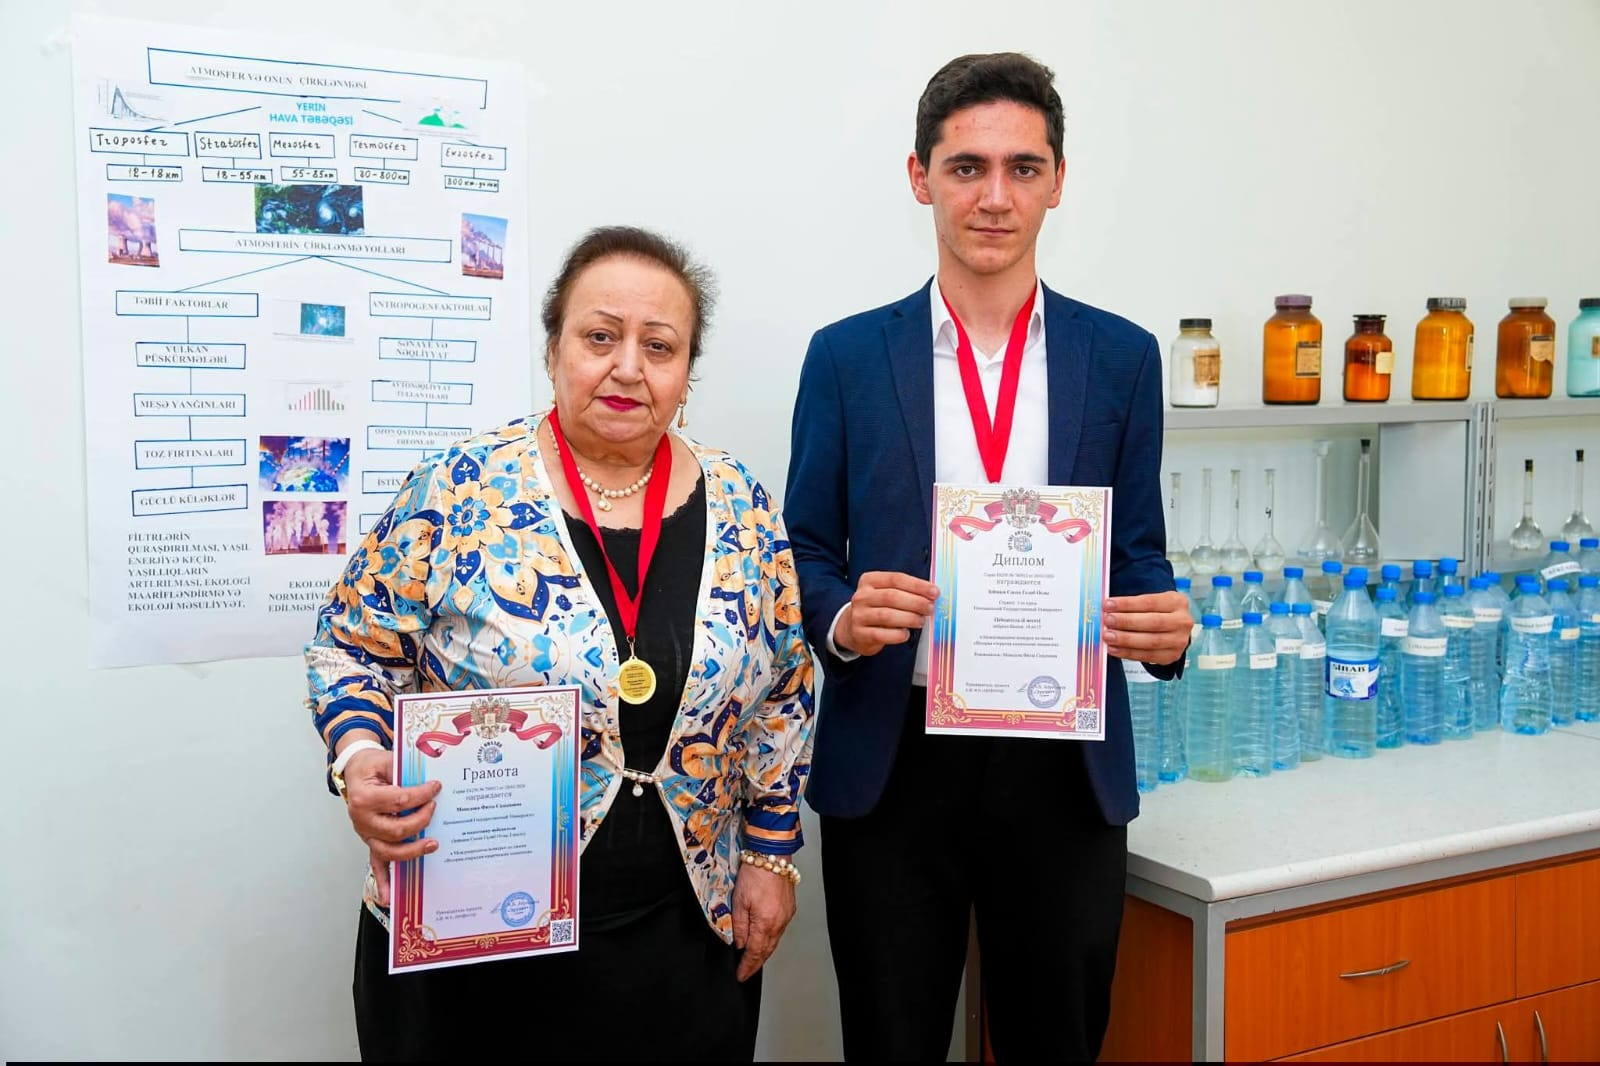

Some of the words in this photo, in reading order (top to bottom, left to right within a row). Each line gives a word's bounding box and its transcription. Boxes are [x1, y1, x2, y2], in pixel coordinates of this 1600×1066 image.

[190, 66, 245, 81] ATMOSFER
[248, 73, 262, 82] VƏ
[265, 74, 292, 84] ONUN
[296, 102, 326, 112] YERİN
[269, 113, 298, 123] HAVA
[301, 114, 353, 126] TƏBƏQƏSİ
[235, 239, 300, 249] ATMOSFERİN
[364, 243, 405, 254] YOLLARI
[165, 299, 228, 309] FAKTORLAR
[140, 400, 169, 410] MEŞƏ
[171, 399, 236, 409] YANĞINLARI
[144, 450, 167, 459] TOZ
[168, 449, 233, 458] FIRTINALARI
[140, 496, 176, 507] GÜCLÜ
[179, 494, 236, 504] KÜLƏKLƏR
[128, 532, 191, 542] FİLTRLƏRİN
[128, 556, 180, 565] ENERJİYƏ
[992, 553, 1045, 567] Диплом
[228, 589, 242, 597] VƏ
[269, 592, 326, 601] NORMATİVL
[128, 602, 174, 612] EKOLOJİ
[268, 603, 315, 612] EDİLMƏSİ
[463, 767, 519, 783] Грамота
